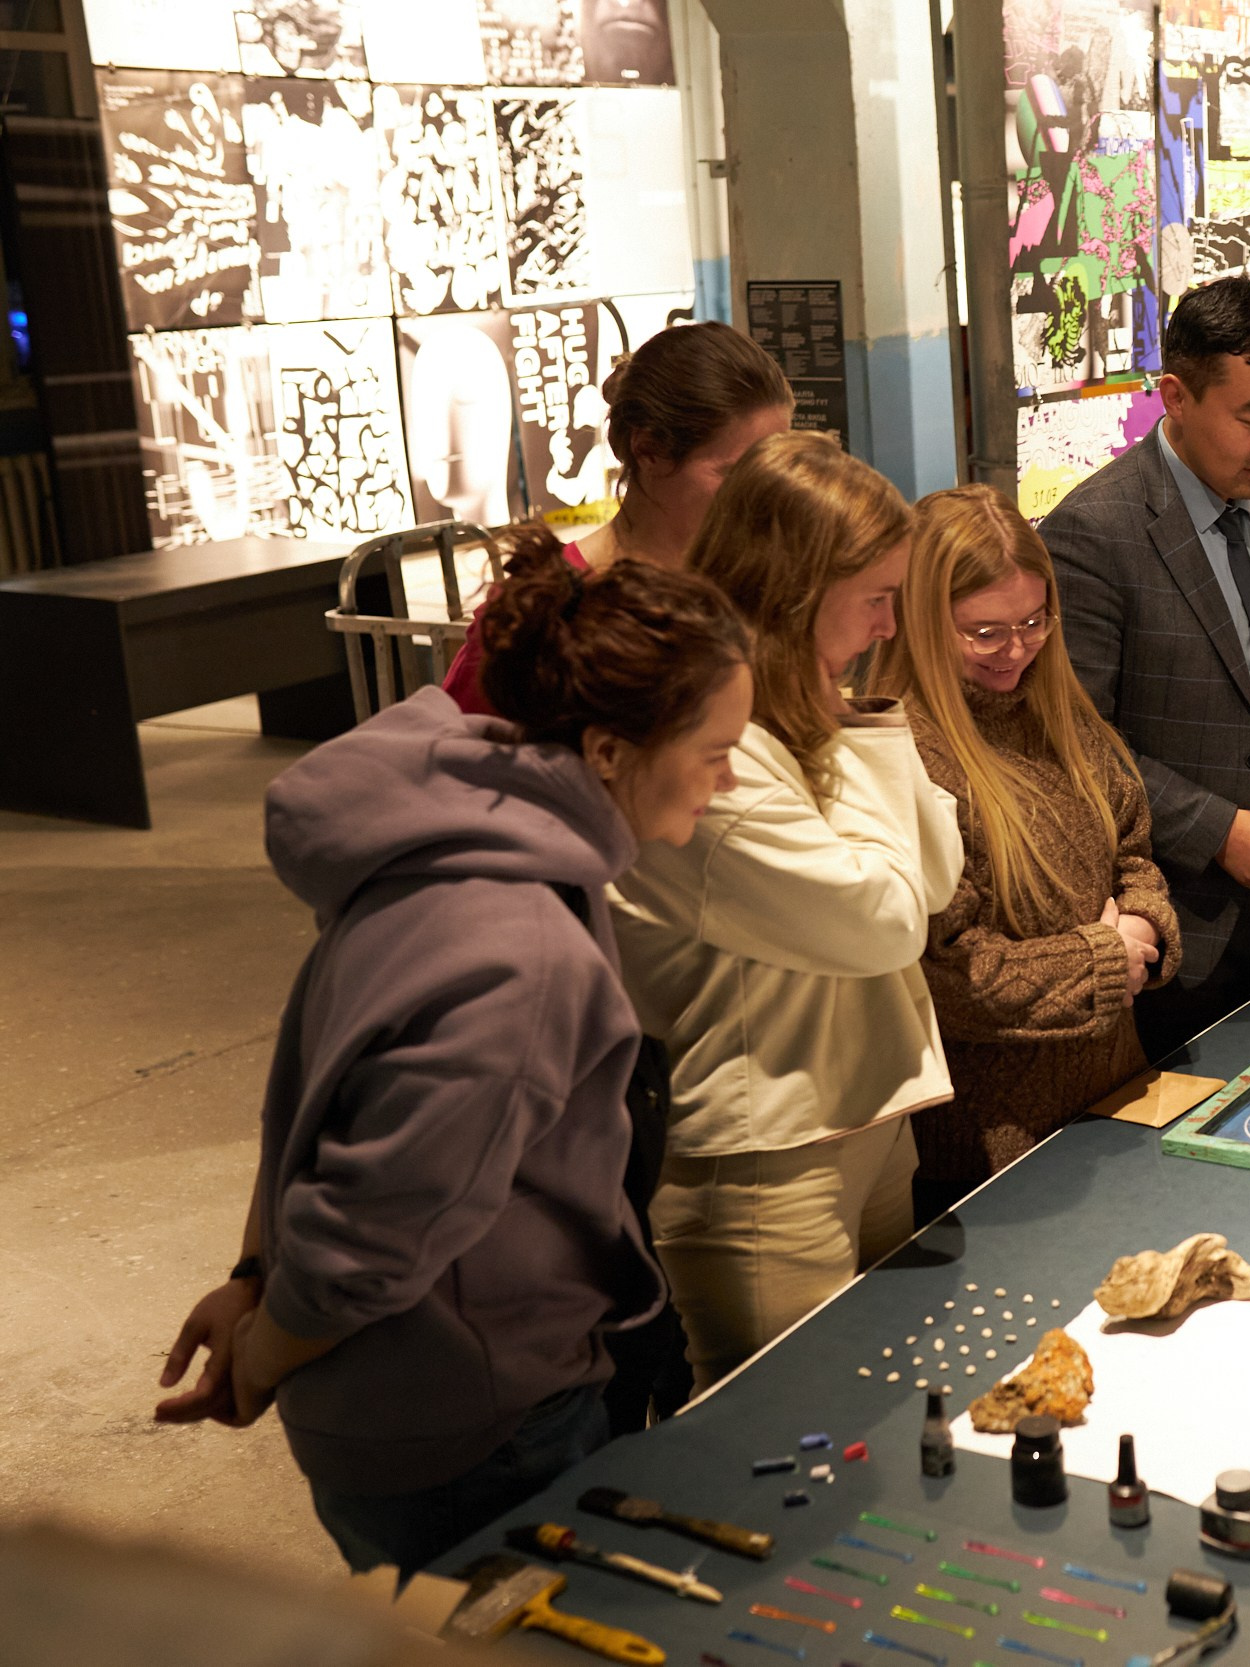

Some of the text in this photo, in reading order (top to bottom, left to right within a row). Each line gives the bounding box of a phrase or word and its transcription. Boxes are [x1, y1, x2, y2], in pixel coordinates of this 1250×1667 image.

[510, 312, 547, 427] FIGHT
[536, 309, 570, 431] AFTER
[560, 308, 590, 387] HUG
